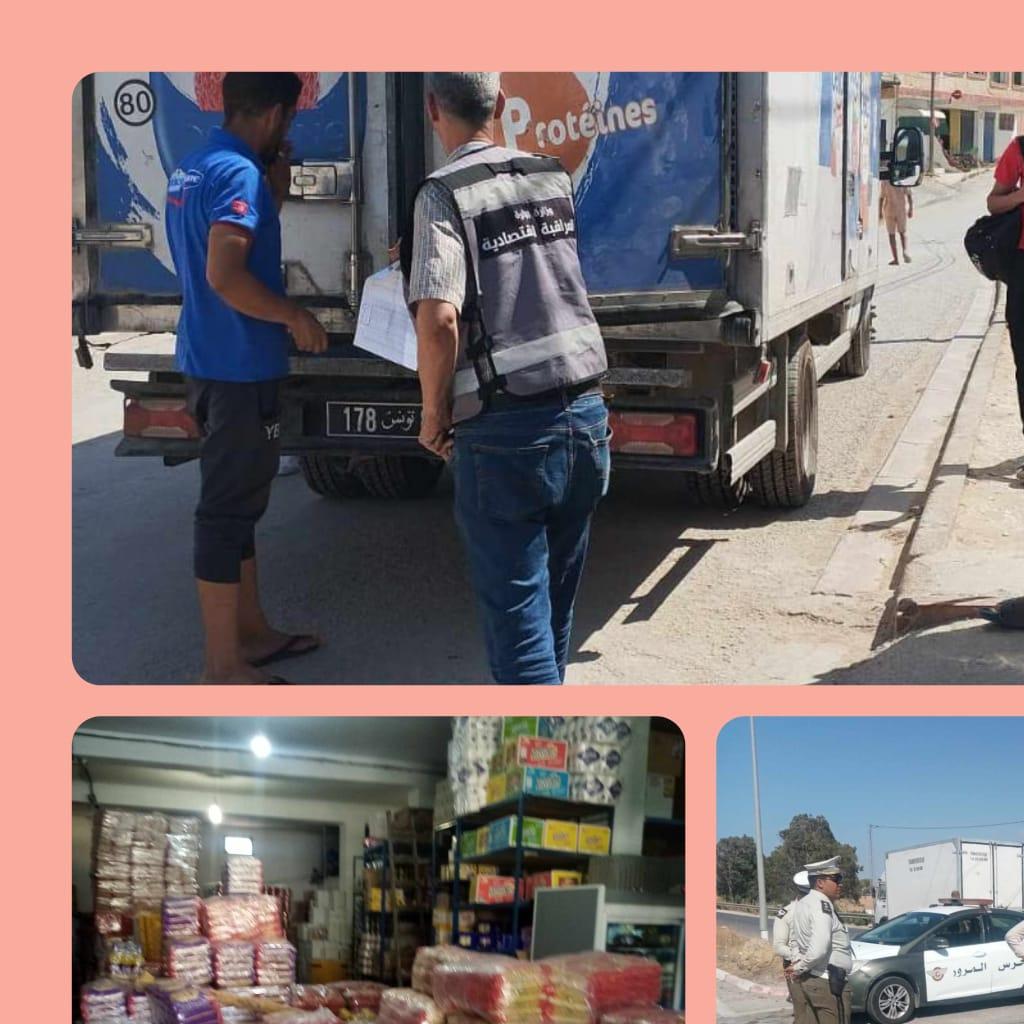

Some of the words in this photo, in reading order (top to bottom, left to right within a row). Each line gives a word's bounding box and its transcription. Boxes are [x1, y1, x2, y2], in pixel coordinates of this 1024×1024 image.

[120, 90, 151, 115] 80
[343, 407, 377, 432] 178
[380, 410, 415, 431] تونس
